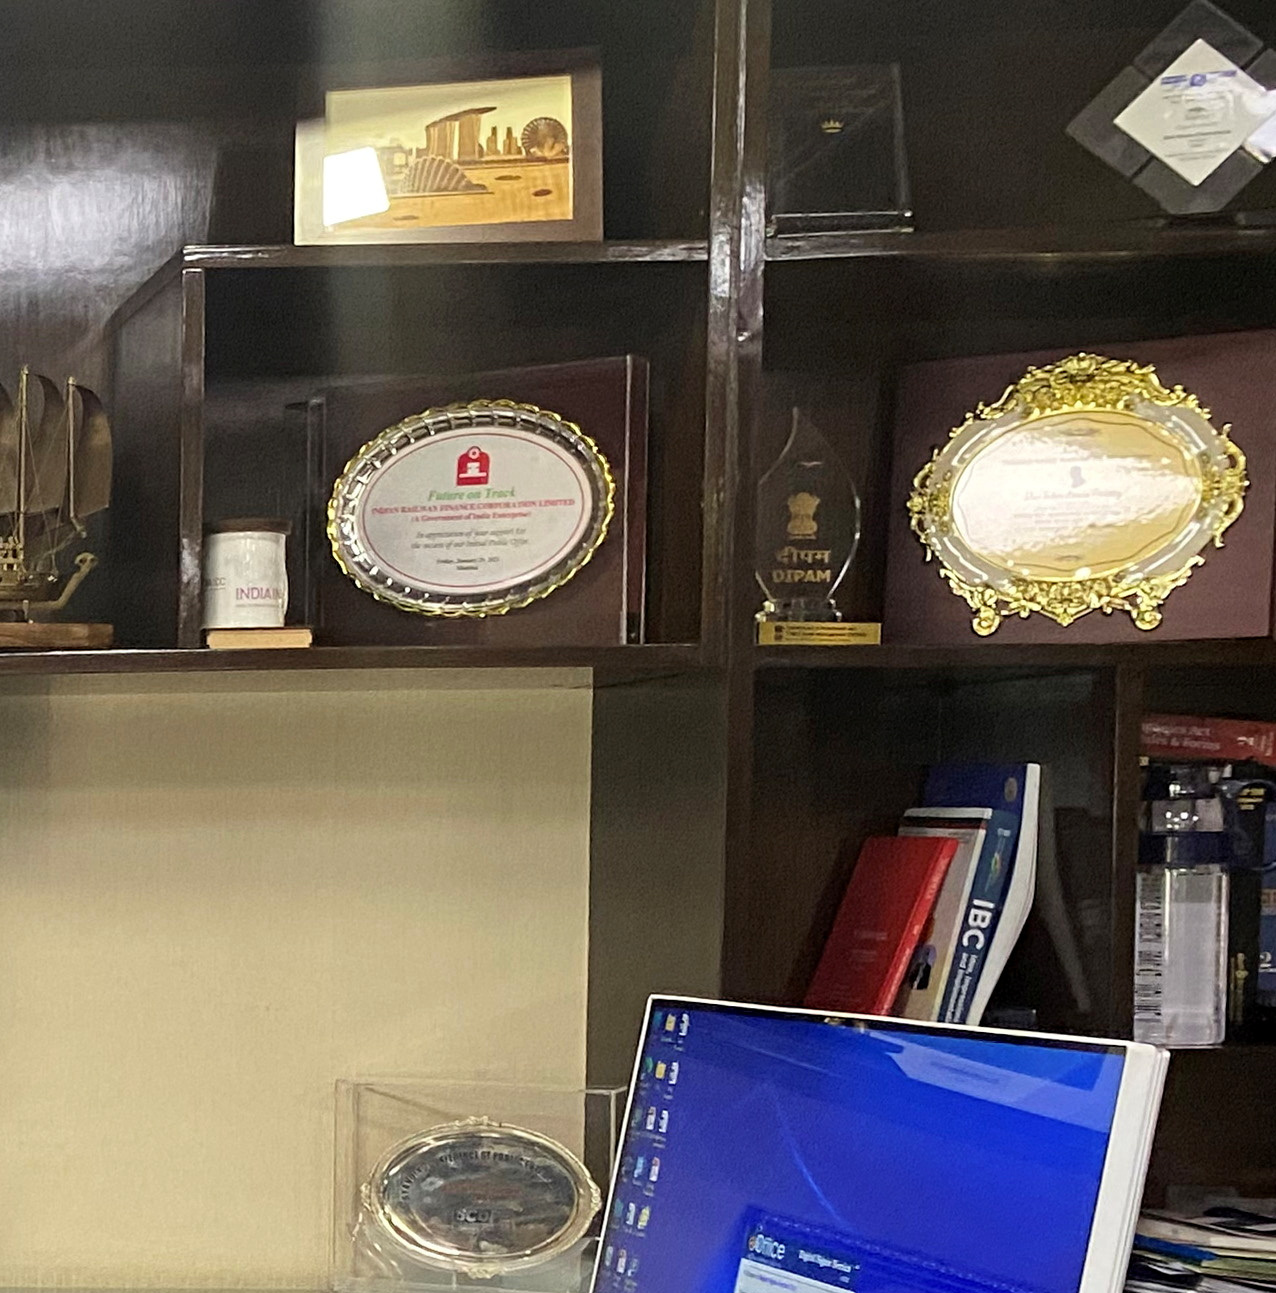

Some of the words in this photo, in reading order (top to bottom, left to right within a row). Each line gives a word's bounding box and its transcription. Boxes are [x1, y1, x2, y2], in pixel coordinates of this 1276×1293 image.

[775, 546, 831, 564] दीपम
[772, 569, 831, 583] DIPAM
[962, 899, 995, 950] IBC
[959, 952, 969, 969] and
